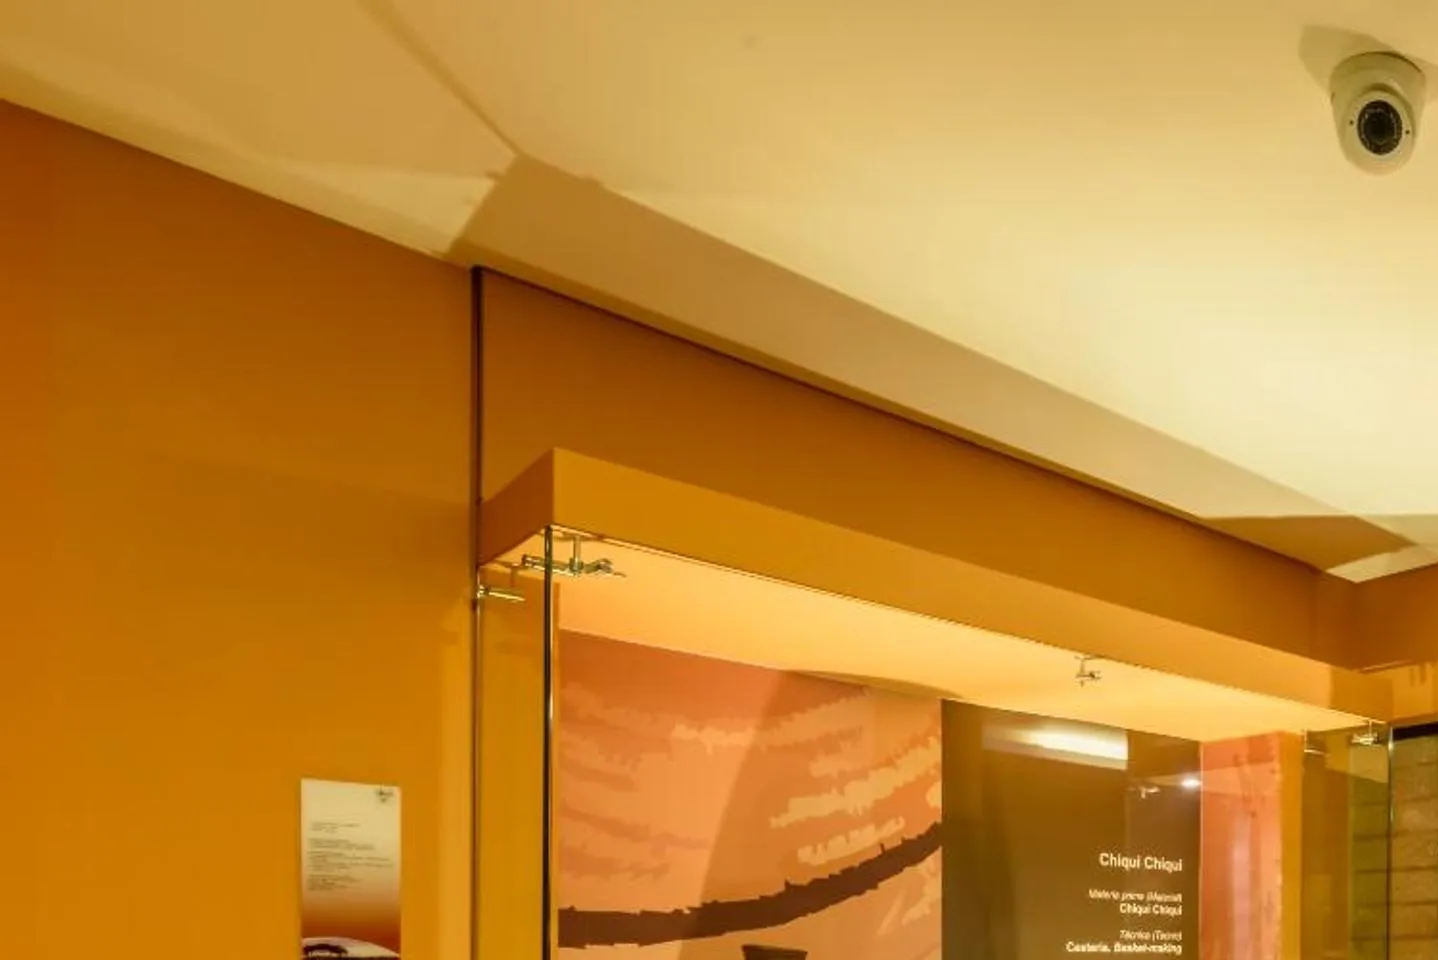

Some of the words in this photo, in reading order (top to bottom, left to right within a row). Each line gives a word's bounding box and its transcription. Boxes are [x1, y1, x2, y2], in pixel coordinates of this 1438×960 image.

[1099, 853, 1141, 871] Chiqui
[1144, 856, 1183, 873] Chiqui
[1119, 904, 1150, 916] Chiqui
[1152, 905, 1183, 917] Chiqui
